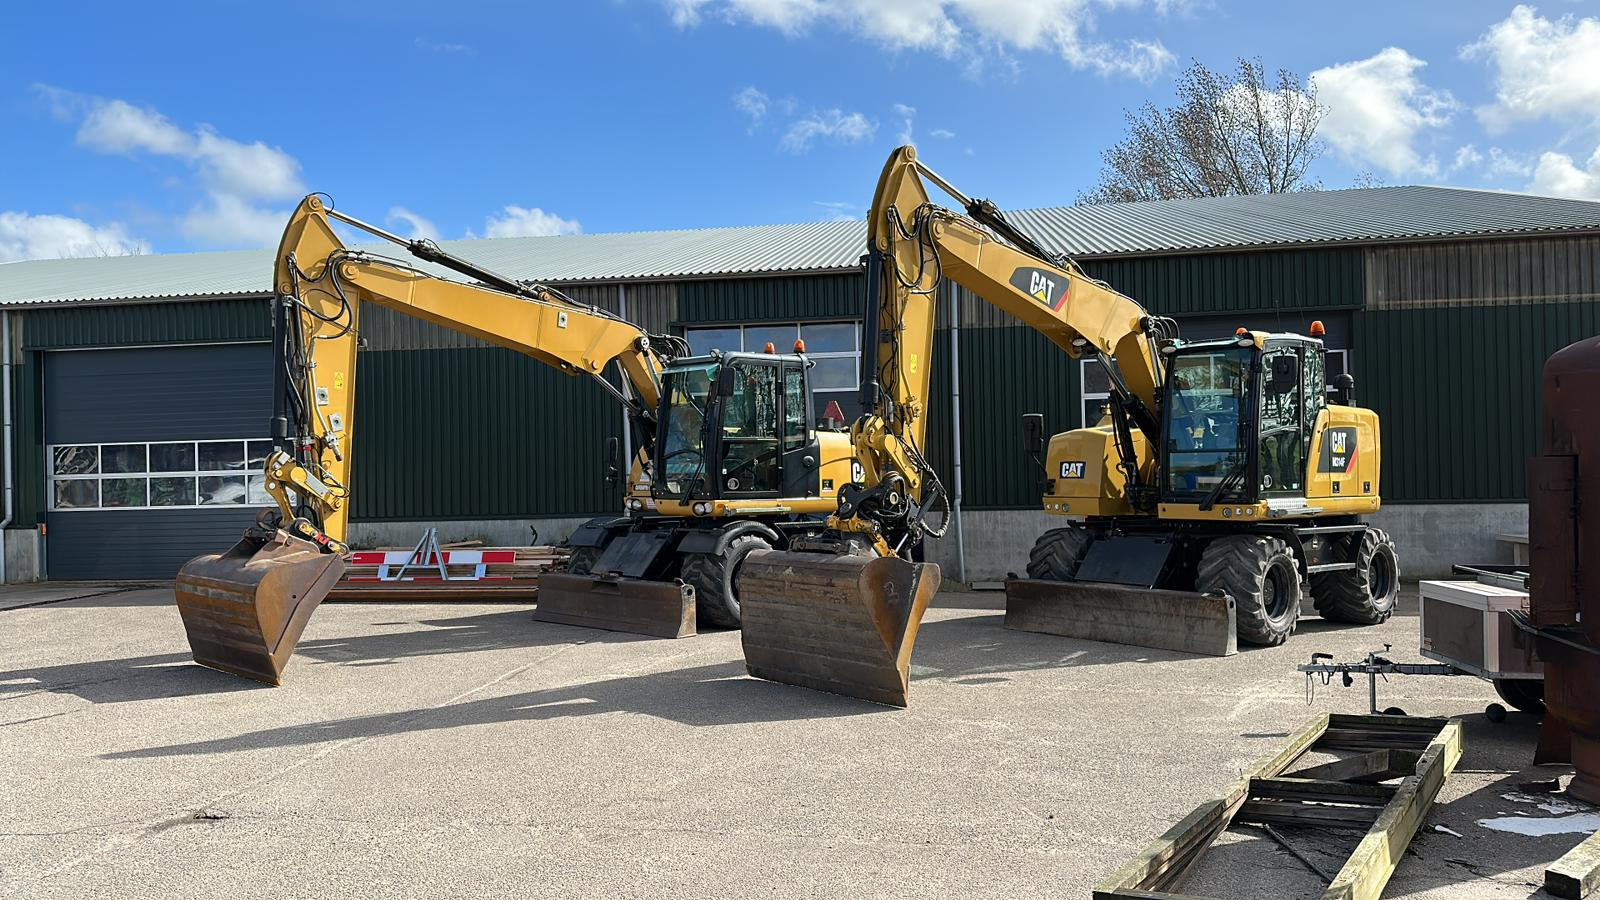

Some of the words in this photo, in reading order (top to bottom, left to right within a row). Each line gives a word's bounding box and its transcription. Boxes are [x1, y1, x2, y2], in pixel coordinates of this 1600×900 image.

[1029, 270, 1055, 305] CAT
[1332, 431, 1347, 453] CAT
[1061, 462, 1084, 478] CAT
